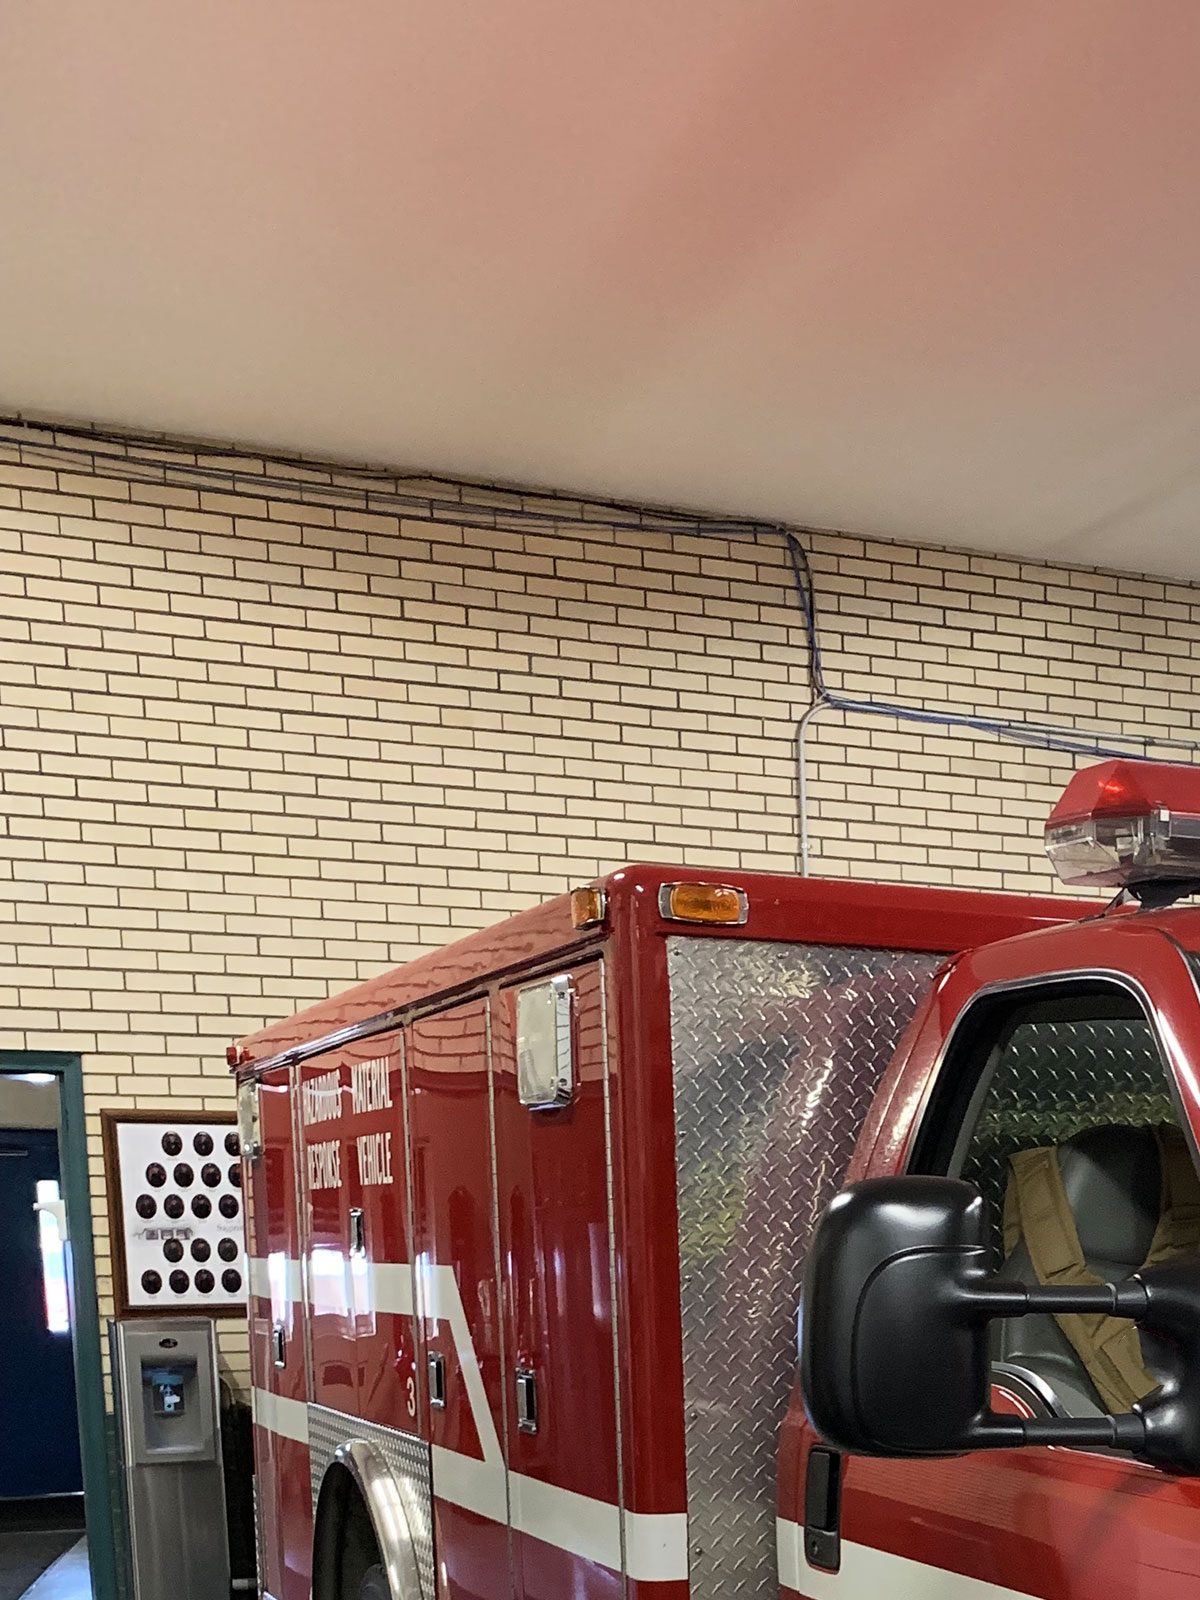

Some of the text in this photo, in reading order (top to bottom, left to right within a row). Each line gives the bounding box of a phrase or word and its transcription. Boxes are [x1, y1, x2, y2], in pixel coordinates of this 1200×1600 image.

[350, 1056, 393, 1115] MATERIAL
[307, 1132, 393, 1190] RESPONSE VEHICLE
[406, 1376, 416, 1417] 3
